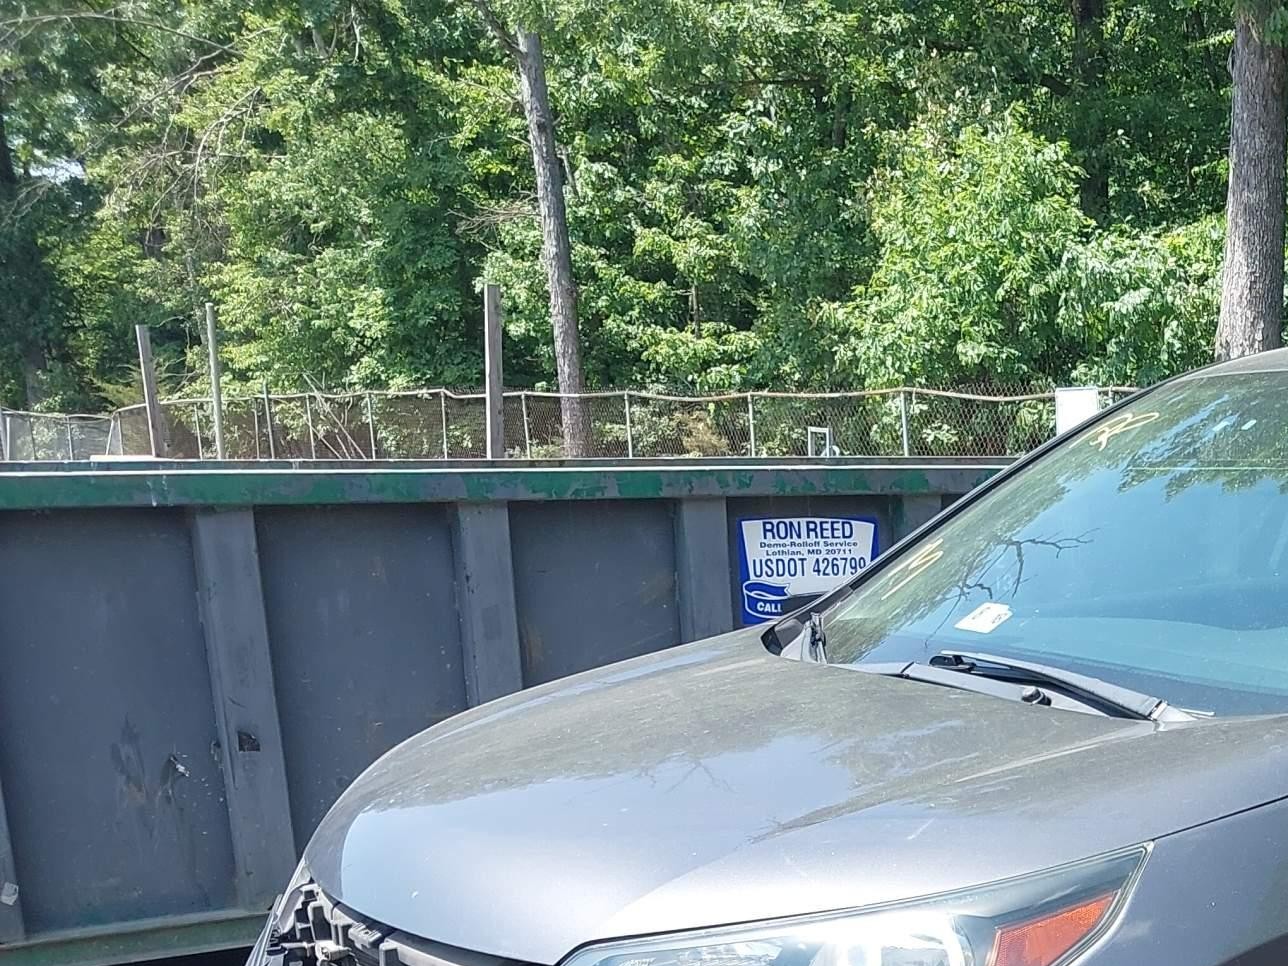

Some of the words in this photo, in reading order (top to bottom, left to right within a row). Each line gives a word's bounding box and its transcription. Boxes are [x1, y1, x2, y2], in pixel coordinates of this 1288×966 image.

[762, 521, 801, 539] RON
[806, 521, 854, 539] REED
[759, 541, 820, 549] Demo-Rolloff
[766, 549, 804, 557] Lothian,
[752, 558, 807, 577] USDOT
